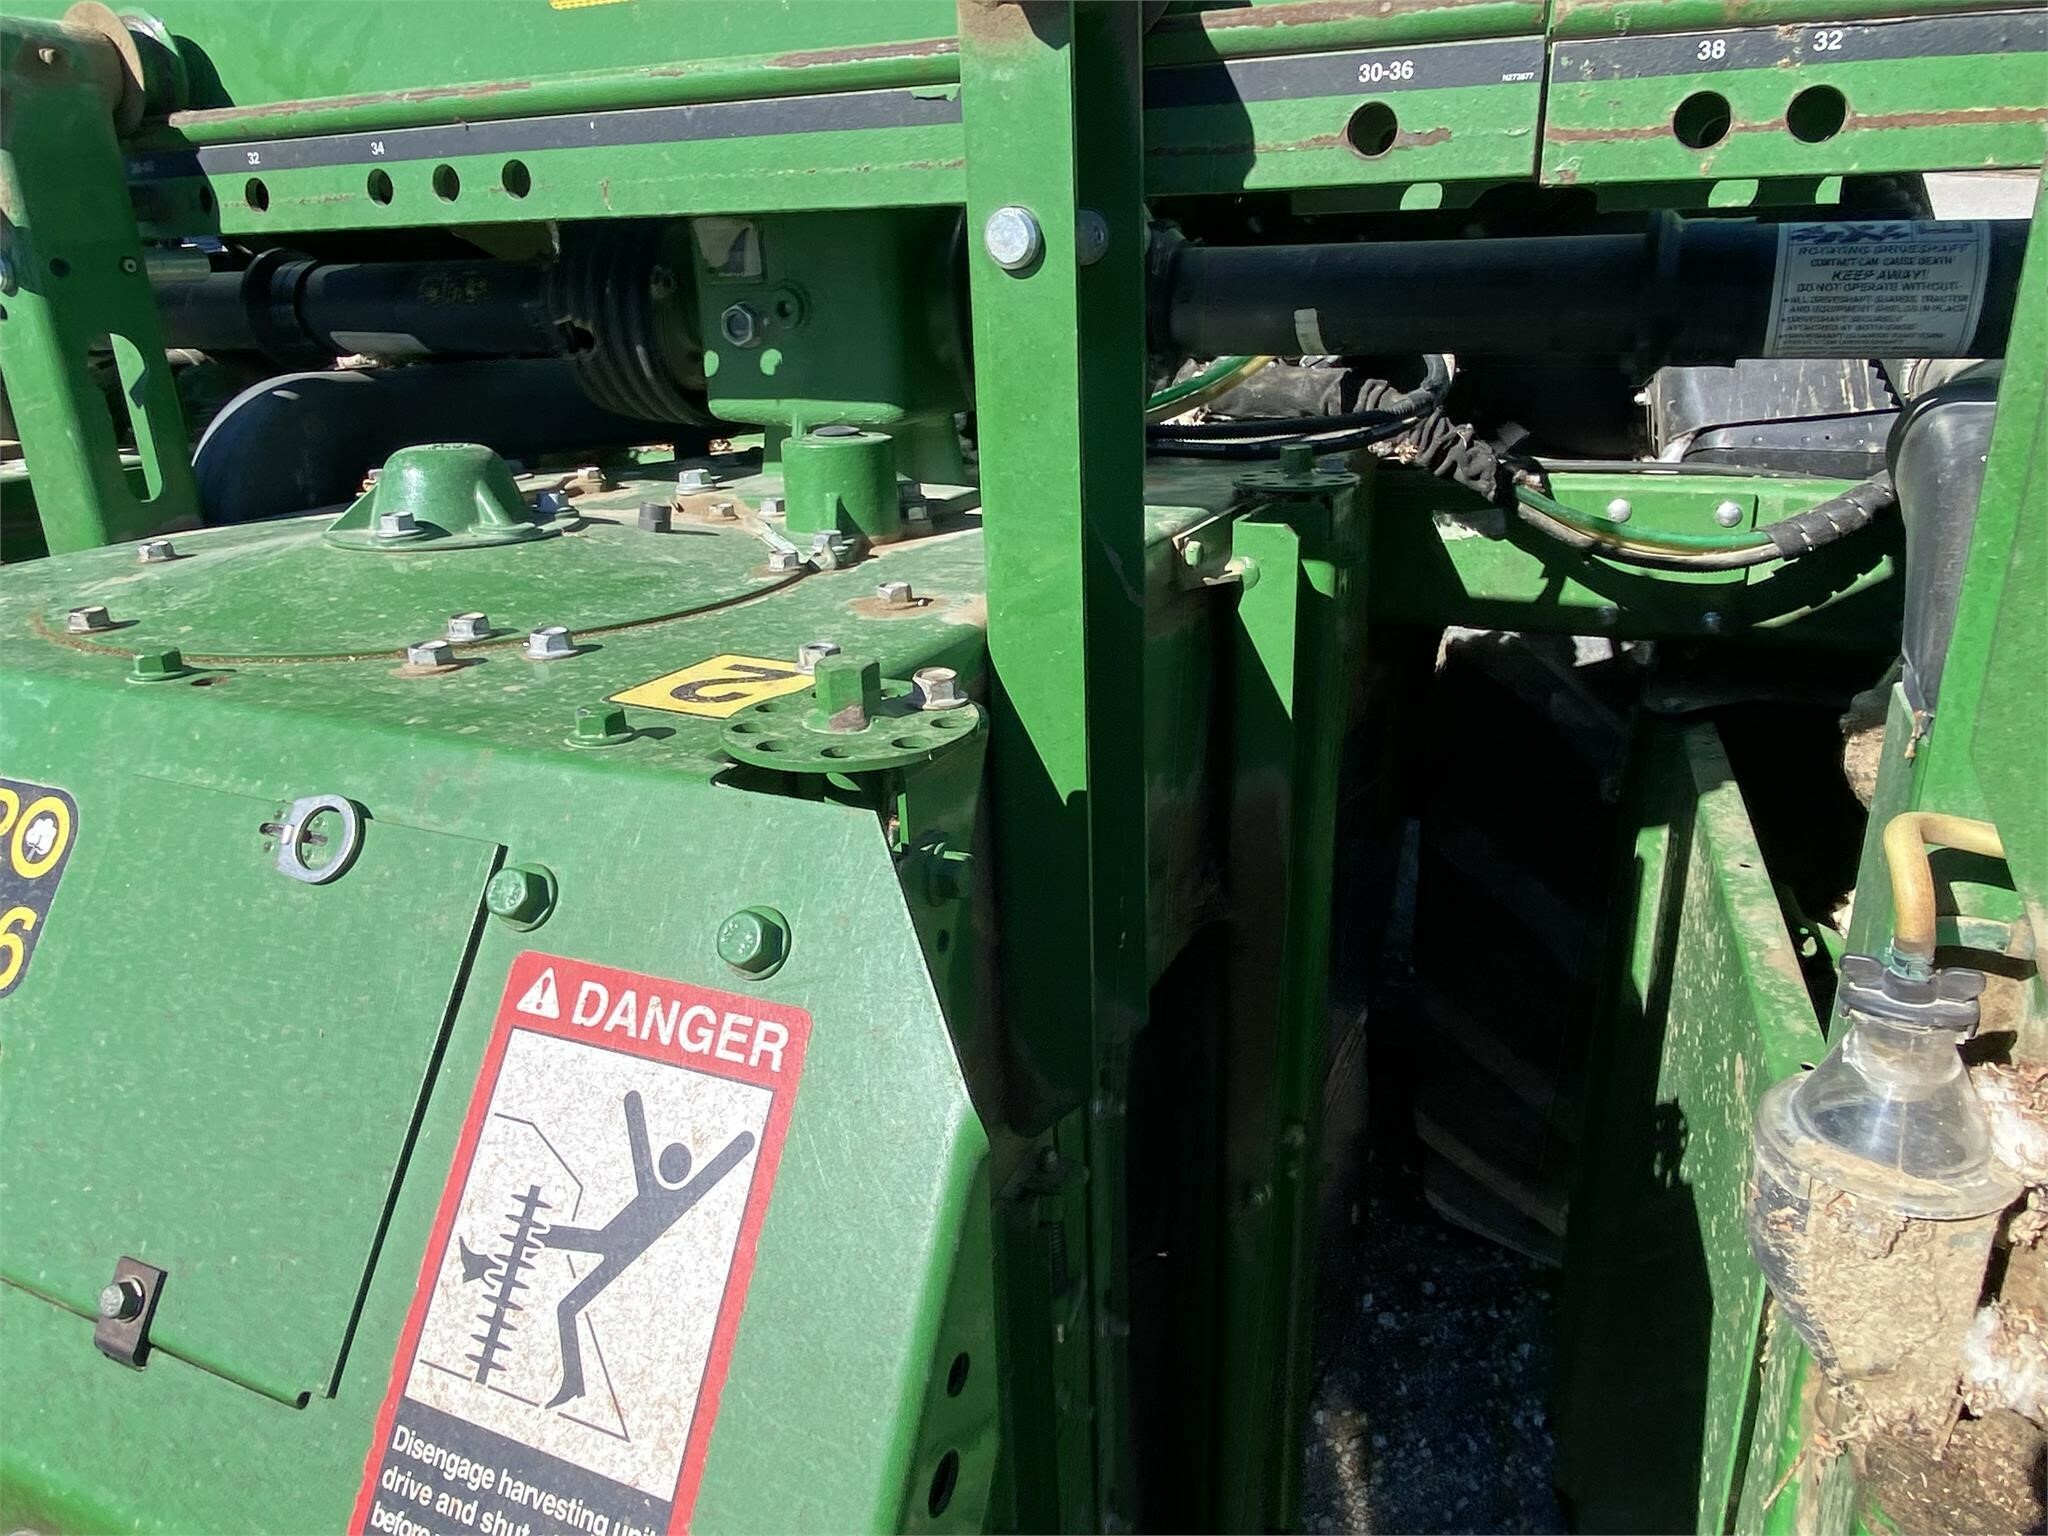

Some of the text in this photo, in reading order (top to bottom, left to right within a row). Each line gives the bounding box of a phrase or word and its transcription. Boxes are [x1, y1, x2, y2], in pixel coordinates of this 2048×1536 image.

[1697, 39, 1726, 61] 38
[1813, 30, 1843, 52] 32
[1358, 60, 1414, 83] 30-36
[247, 152, 261, 165] 32
[370, 141, 385, 155] 34
[1832, 270, 1876, 281] KEEP
[670, 663, 801, 704] 2
[570, 980, 791, 1074] DANGER
[391, 1424, 497, 1492] Disengage
[498, 1468, 609, 1536] harvesting
[381, 1467, 531, 1536] drive and shut
[370, 1501, 433, 1536] before
